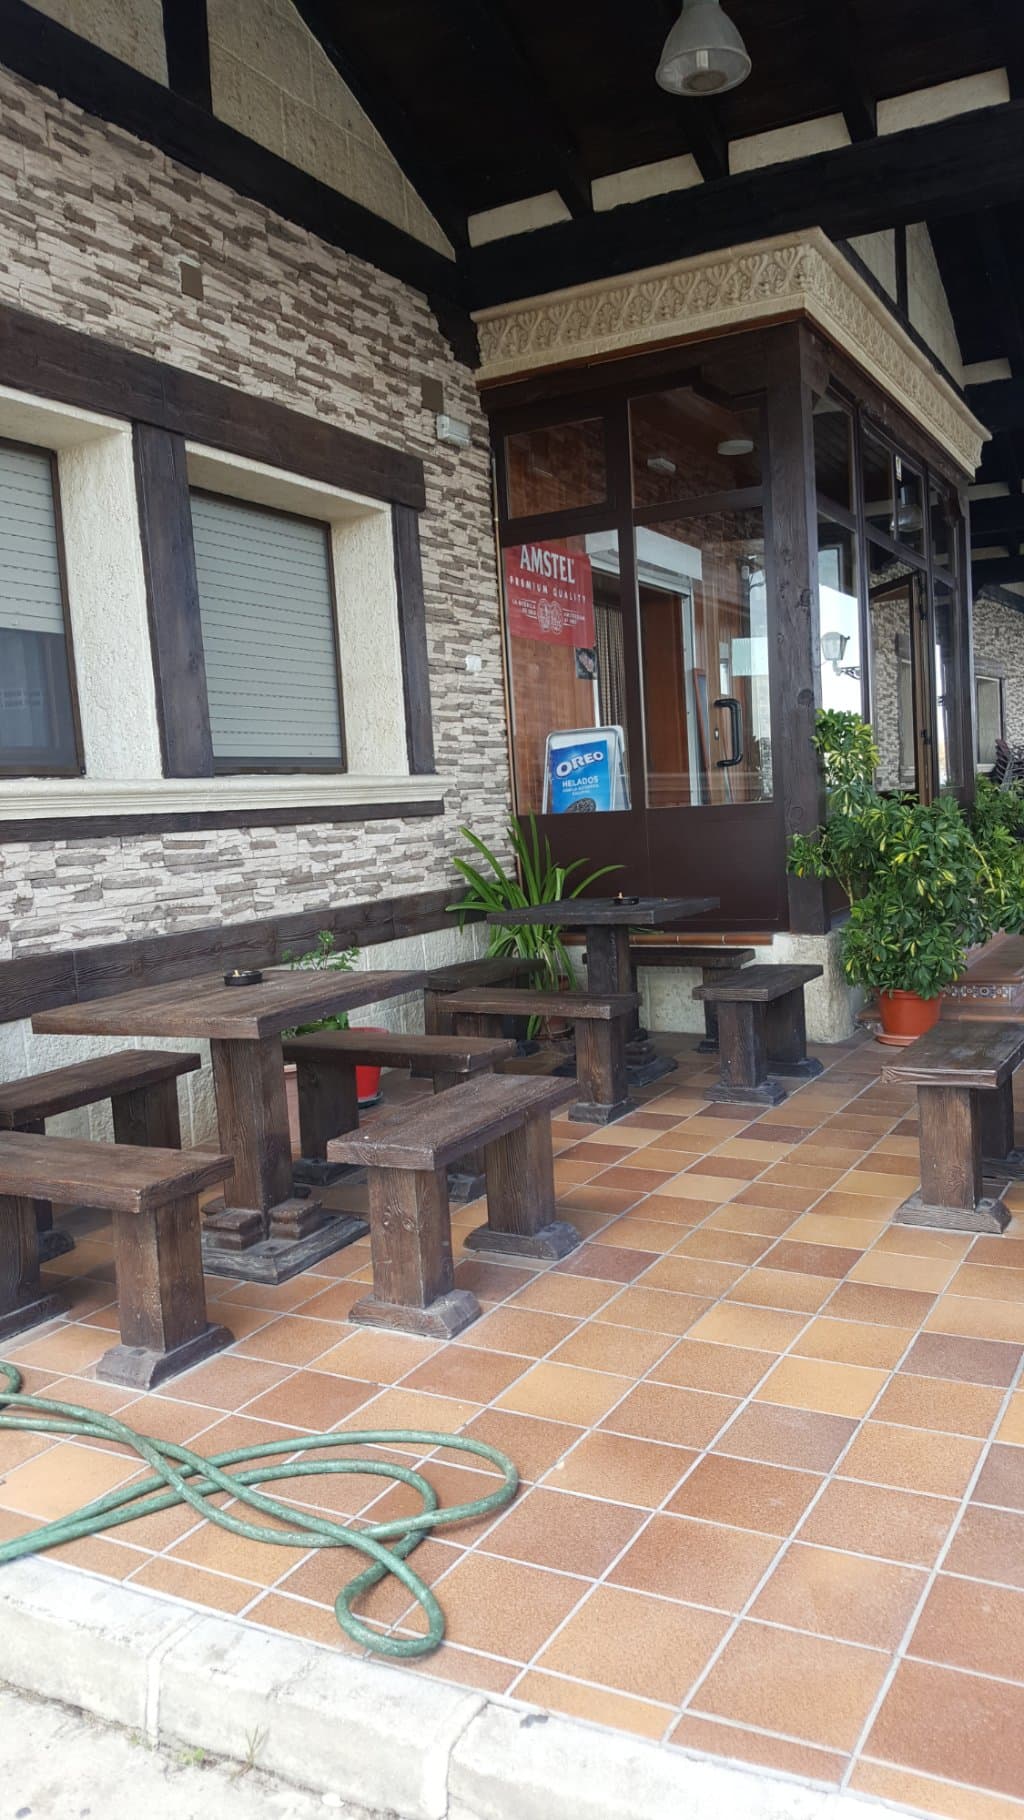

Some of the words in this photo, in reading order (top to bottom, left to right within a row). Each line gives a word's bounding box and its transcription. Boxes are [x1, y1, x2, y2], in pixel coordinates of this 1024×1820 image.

[520, 544, 575, 584] AMSTEL
[552, 586, 586, 604] QUALITY
[556, 751, 604, 777] OREO
[562, 775, 599, 788] HELADOS
